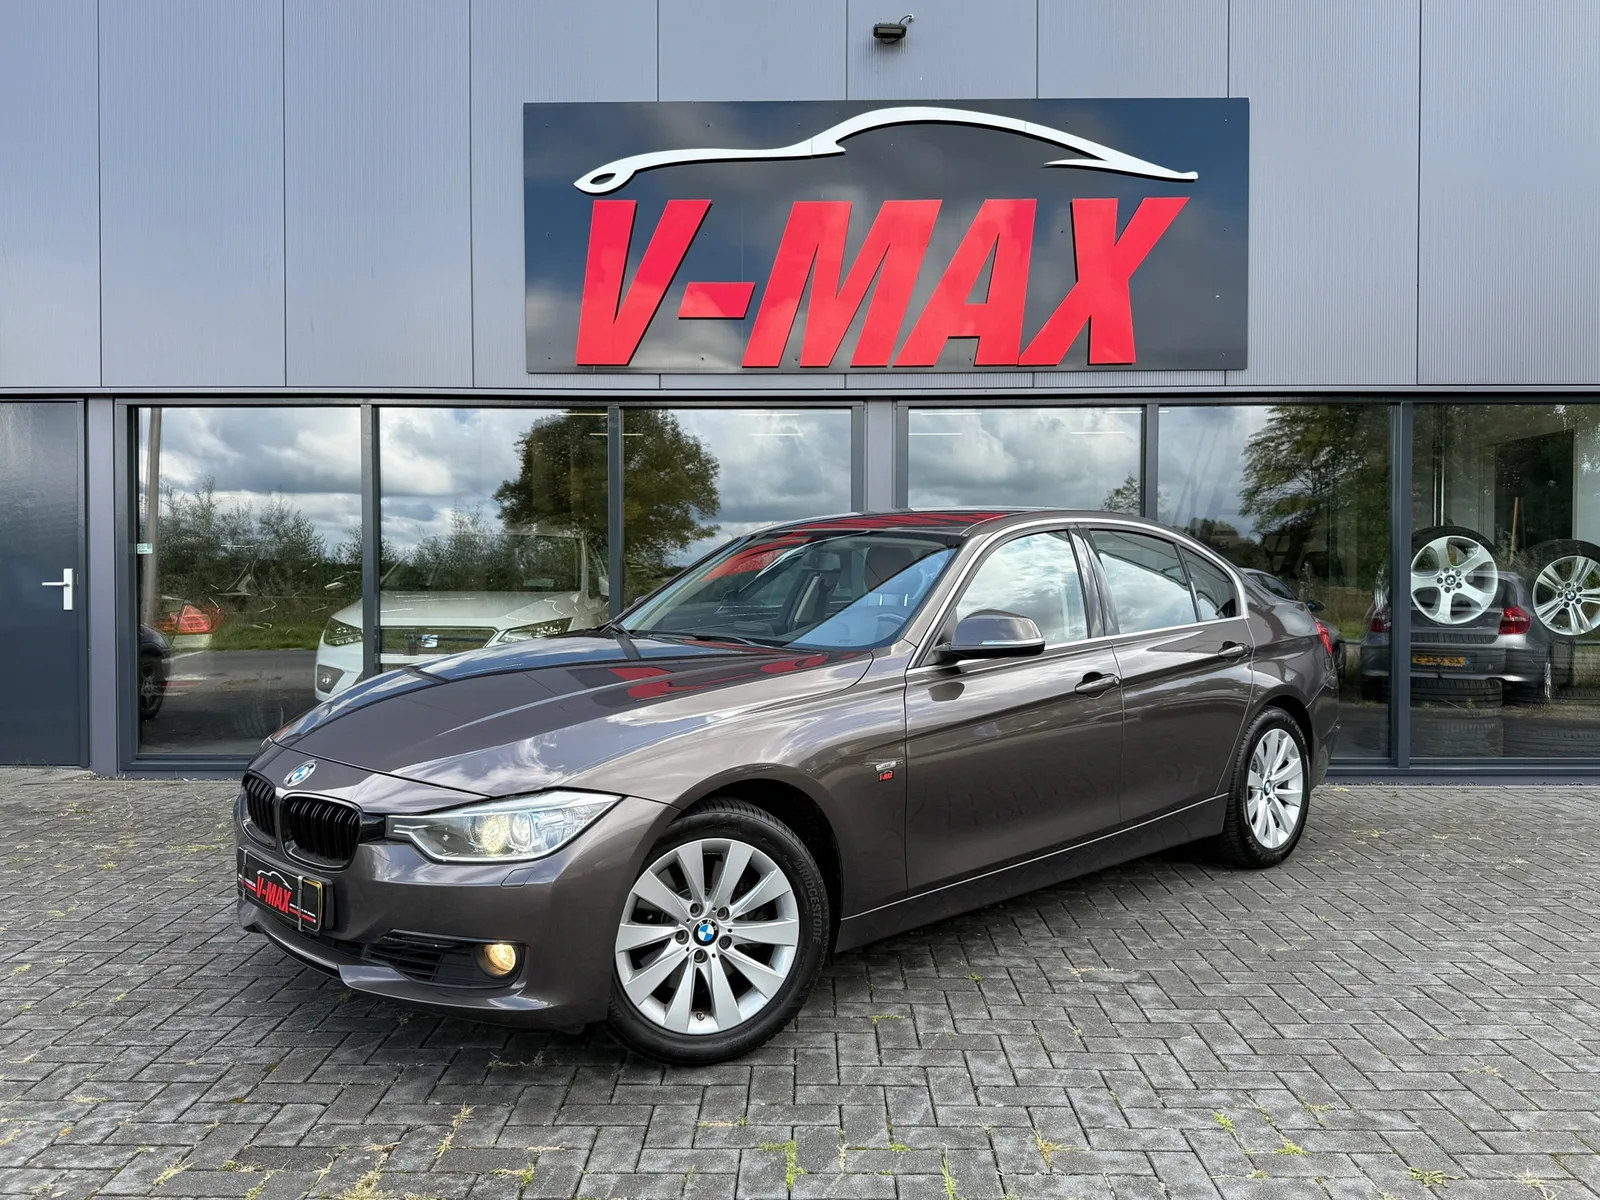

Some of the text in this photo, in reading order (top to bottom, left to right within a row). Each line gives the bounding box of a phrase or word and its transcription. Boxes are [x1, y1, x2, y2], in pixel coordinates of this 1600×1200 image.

[575, 196, 1190, 367] V-MAX
[256, 876, 293, 914] V-MAX
[793, 857, 823, 945] BRIDGESTONE
